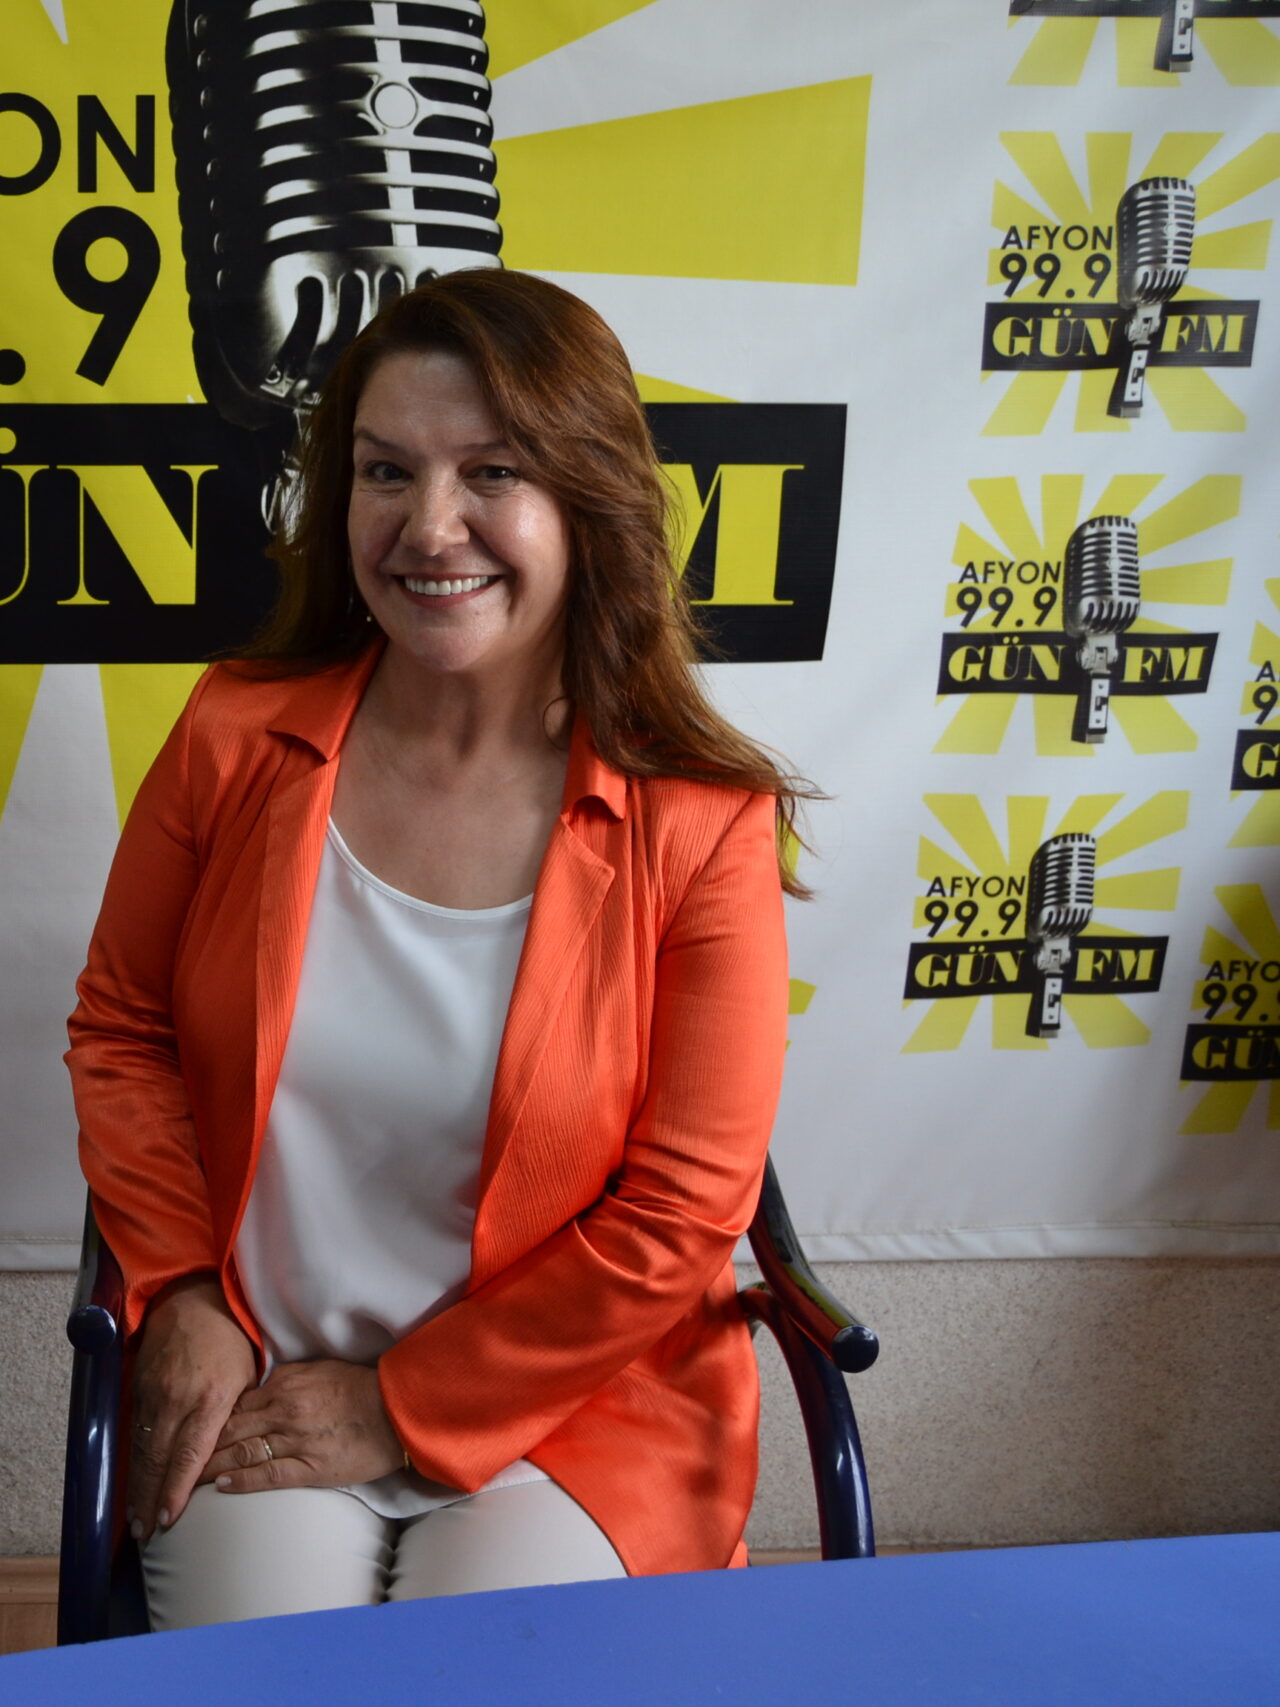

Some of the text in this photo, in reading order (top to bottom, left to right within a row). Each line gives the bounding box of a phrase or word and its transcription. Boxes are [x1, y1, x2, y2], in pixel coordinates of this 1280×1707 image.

[1000, 225, 1114, 251] AFYON
[999, 252, 1112, 299] 99.9
[992, 308, 1249, 358] GÜN FM
[652, 463, 805, 606] M
[958, 561, 1062, 584] AFYON
[956, 586, 1058, 629] 99.9
[948, 636, 1067, 683] GÜN
[1122, 646, 1209, 683] FM
[926, 875, 1025, 897] AFYON
[923, 899, 1021, 938] 99.9
[914, 945, 1160, 988] GÜN FM
[1205, 960, 1280, 983] AFYO
[1201, 983, 1280, 1021] 99.
